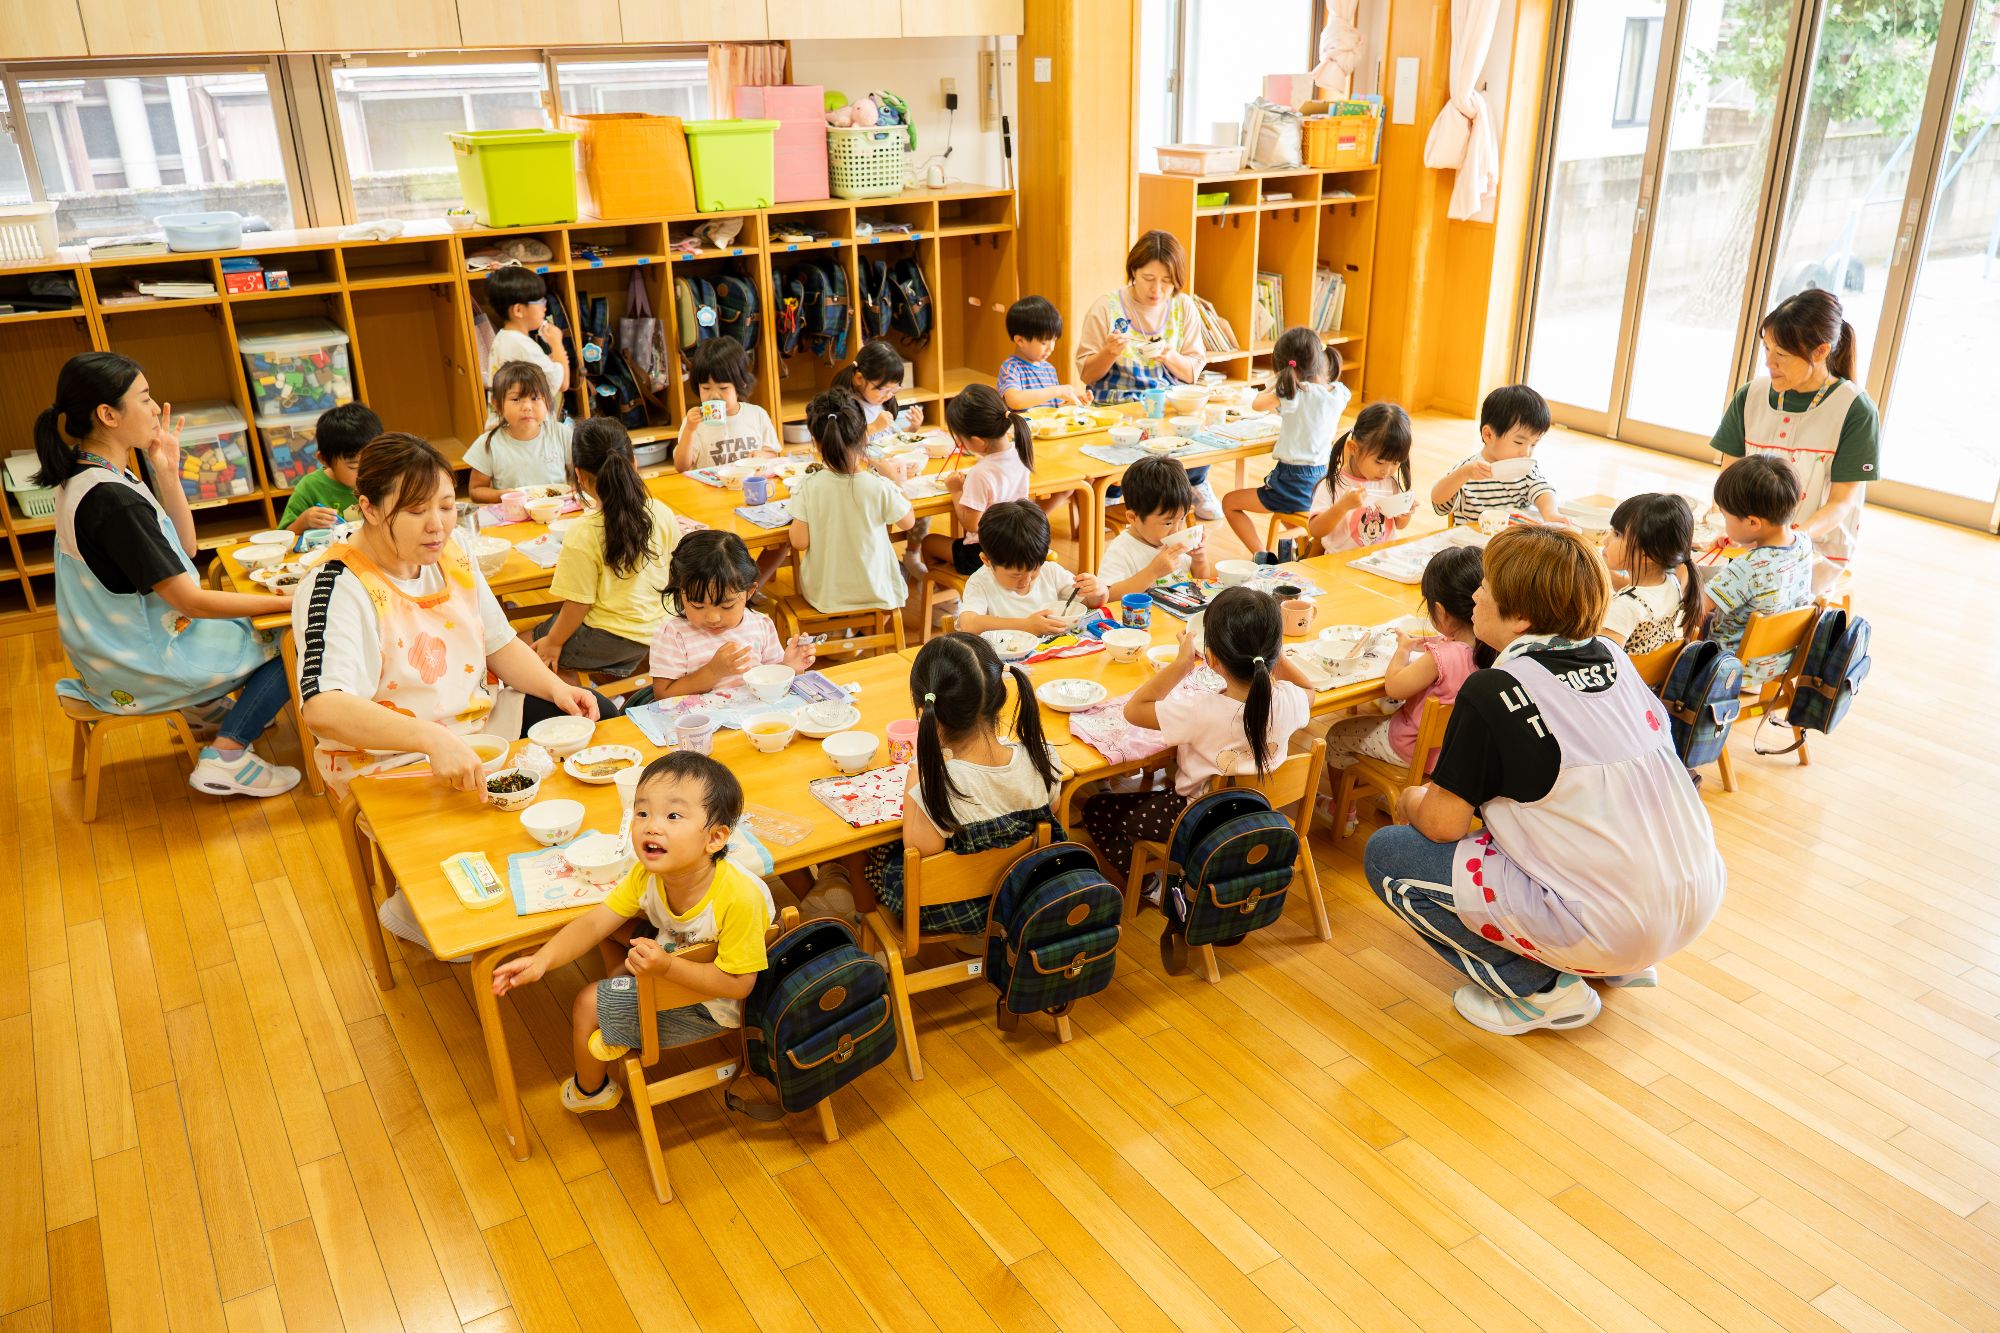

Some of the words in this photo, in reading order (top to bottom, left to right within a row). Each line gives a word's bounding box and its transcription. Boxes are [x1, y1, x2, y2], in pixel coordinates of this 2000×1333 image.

[243, 275, 256, 292] 3
[709, 436, 759, 455] STAR
[1499, 685, 1535, 713] LI
[1555, 665, 1606, 691] GOES
[1604, 661, 1617, 683] H
